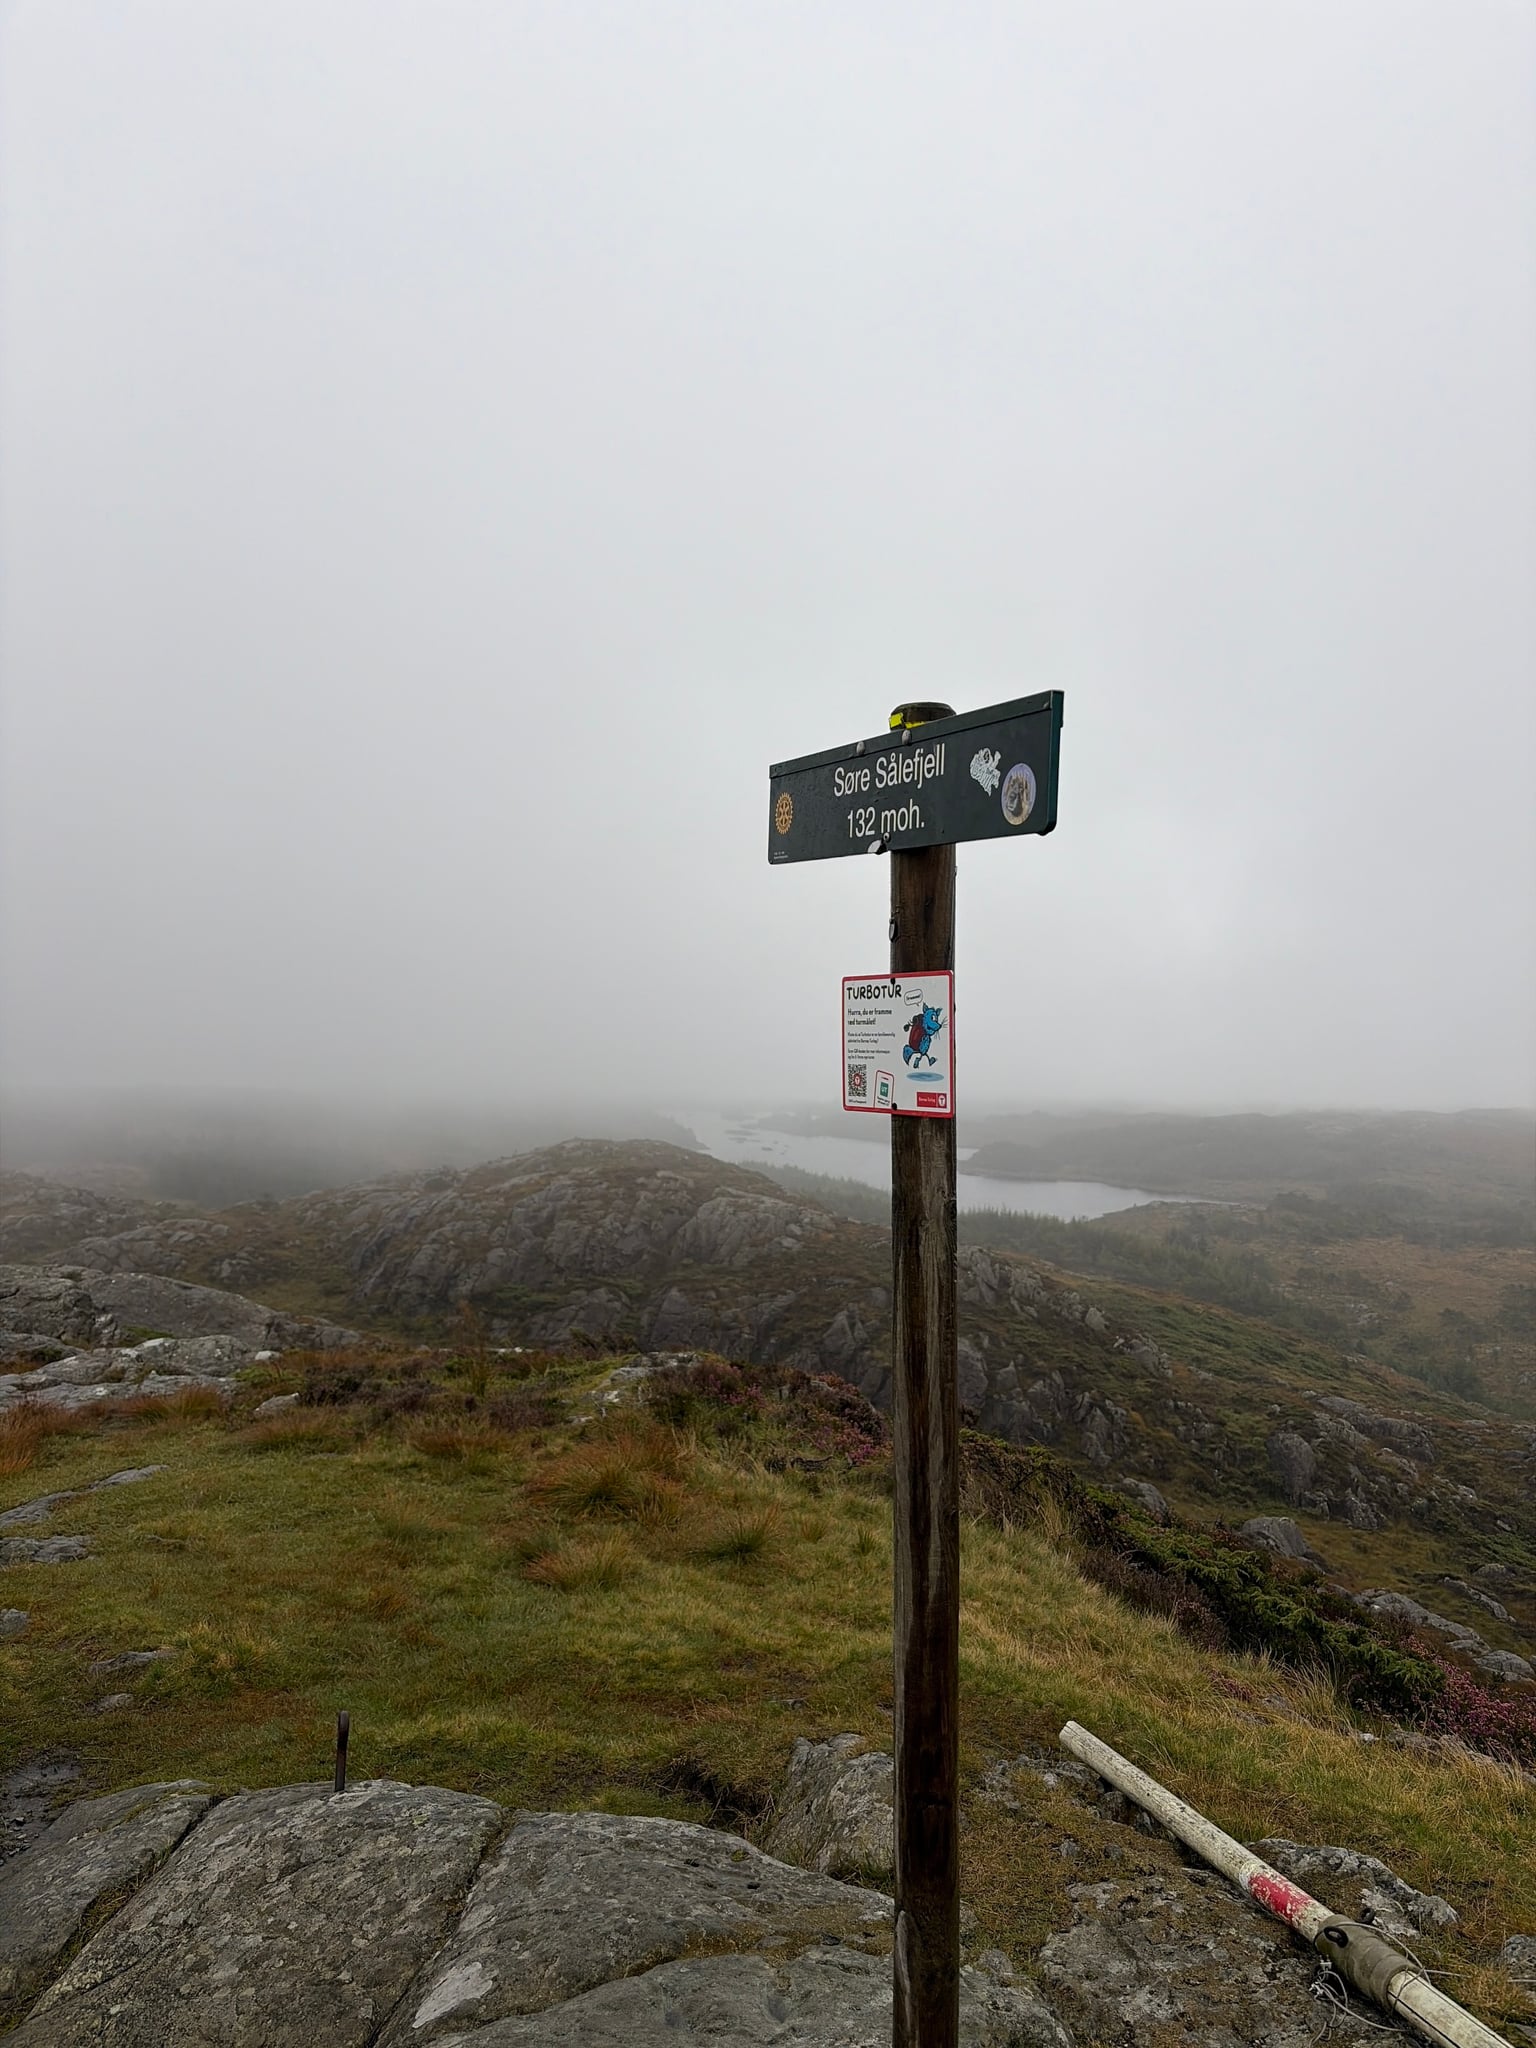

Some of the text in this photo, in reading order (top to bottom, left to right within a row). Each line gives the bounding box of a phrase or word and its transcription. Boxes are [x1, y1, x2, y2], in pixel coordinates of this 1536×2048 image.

[833, 743, 945, 797] Søre Sålefjell
[847, 798, 925, 838] 132 moh.
[846, 984, 902, 1000] TURBOTUR
